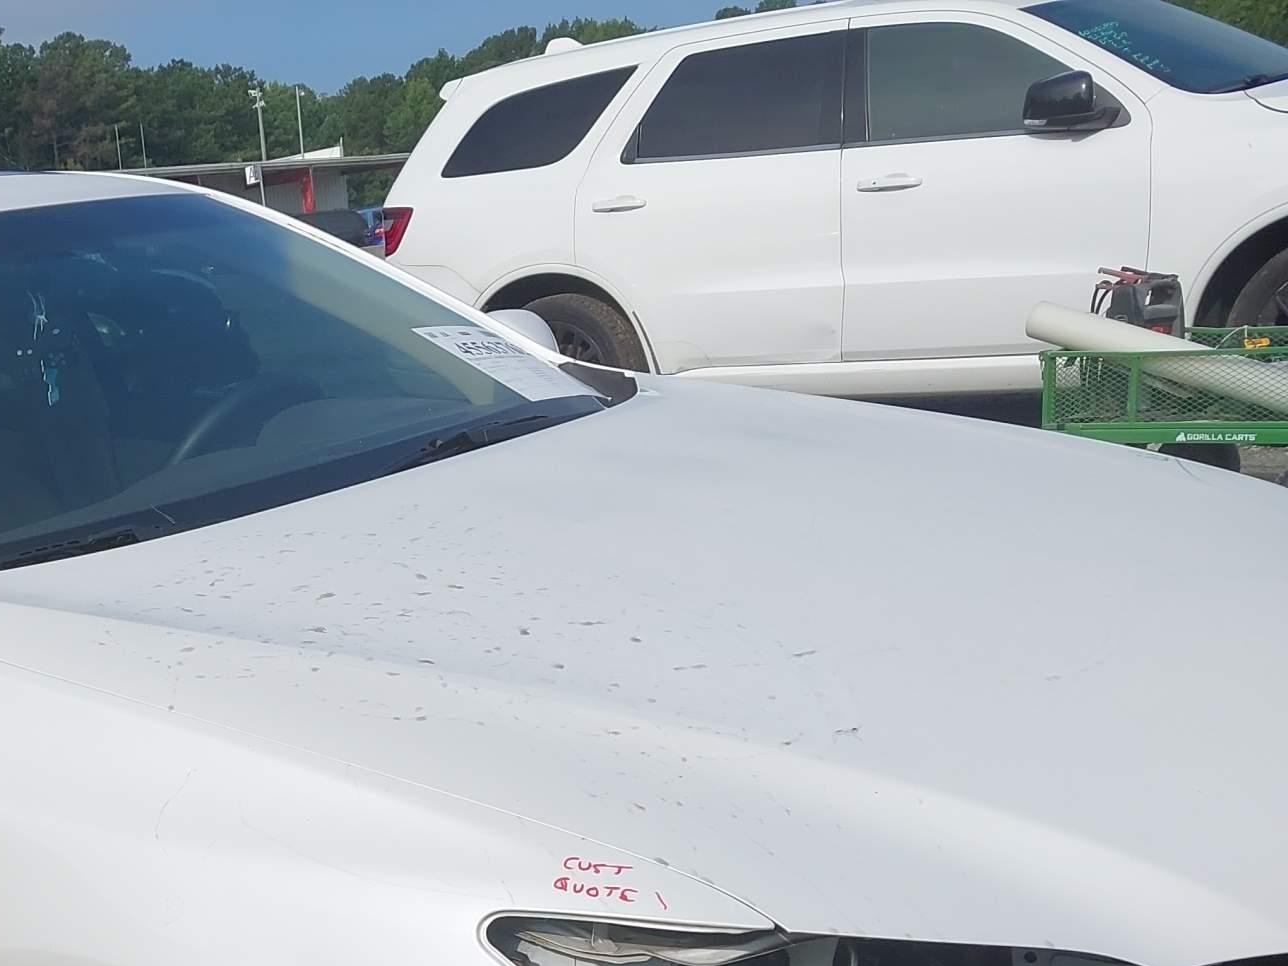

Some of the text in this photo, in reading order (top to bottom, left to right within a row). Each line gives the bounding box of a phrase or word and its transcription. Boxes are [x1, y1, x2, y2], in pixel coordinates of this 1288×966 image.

[1186, 433, 1256, 441] GORILLA CARTS
[563, 856, 633, 875] CUST
[553, 876, 638, 903] QUOTE
